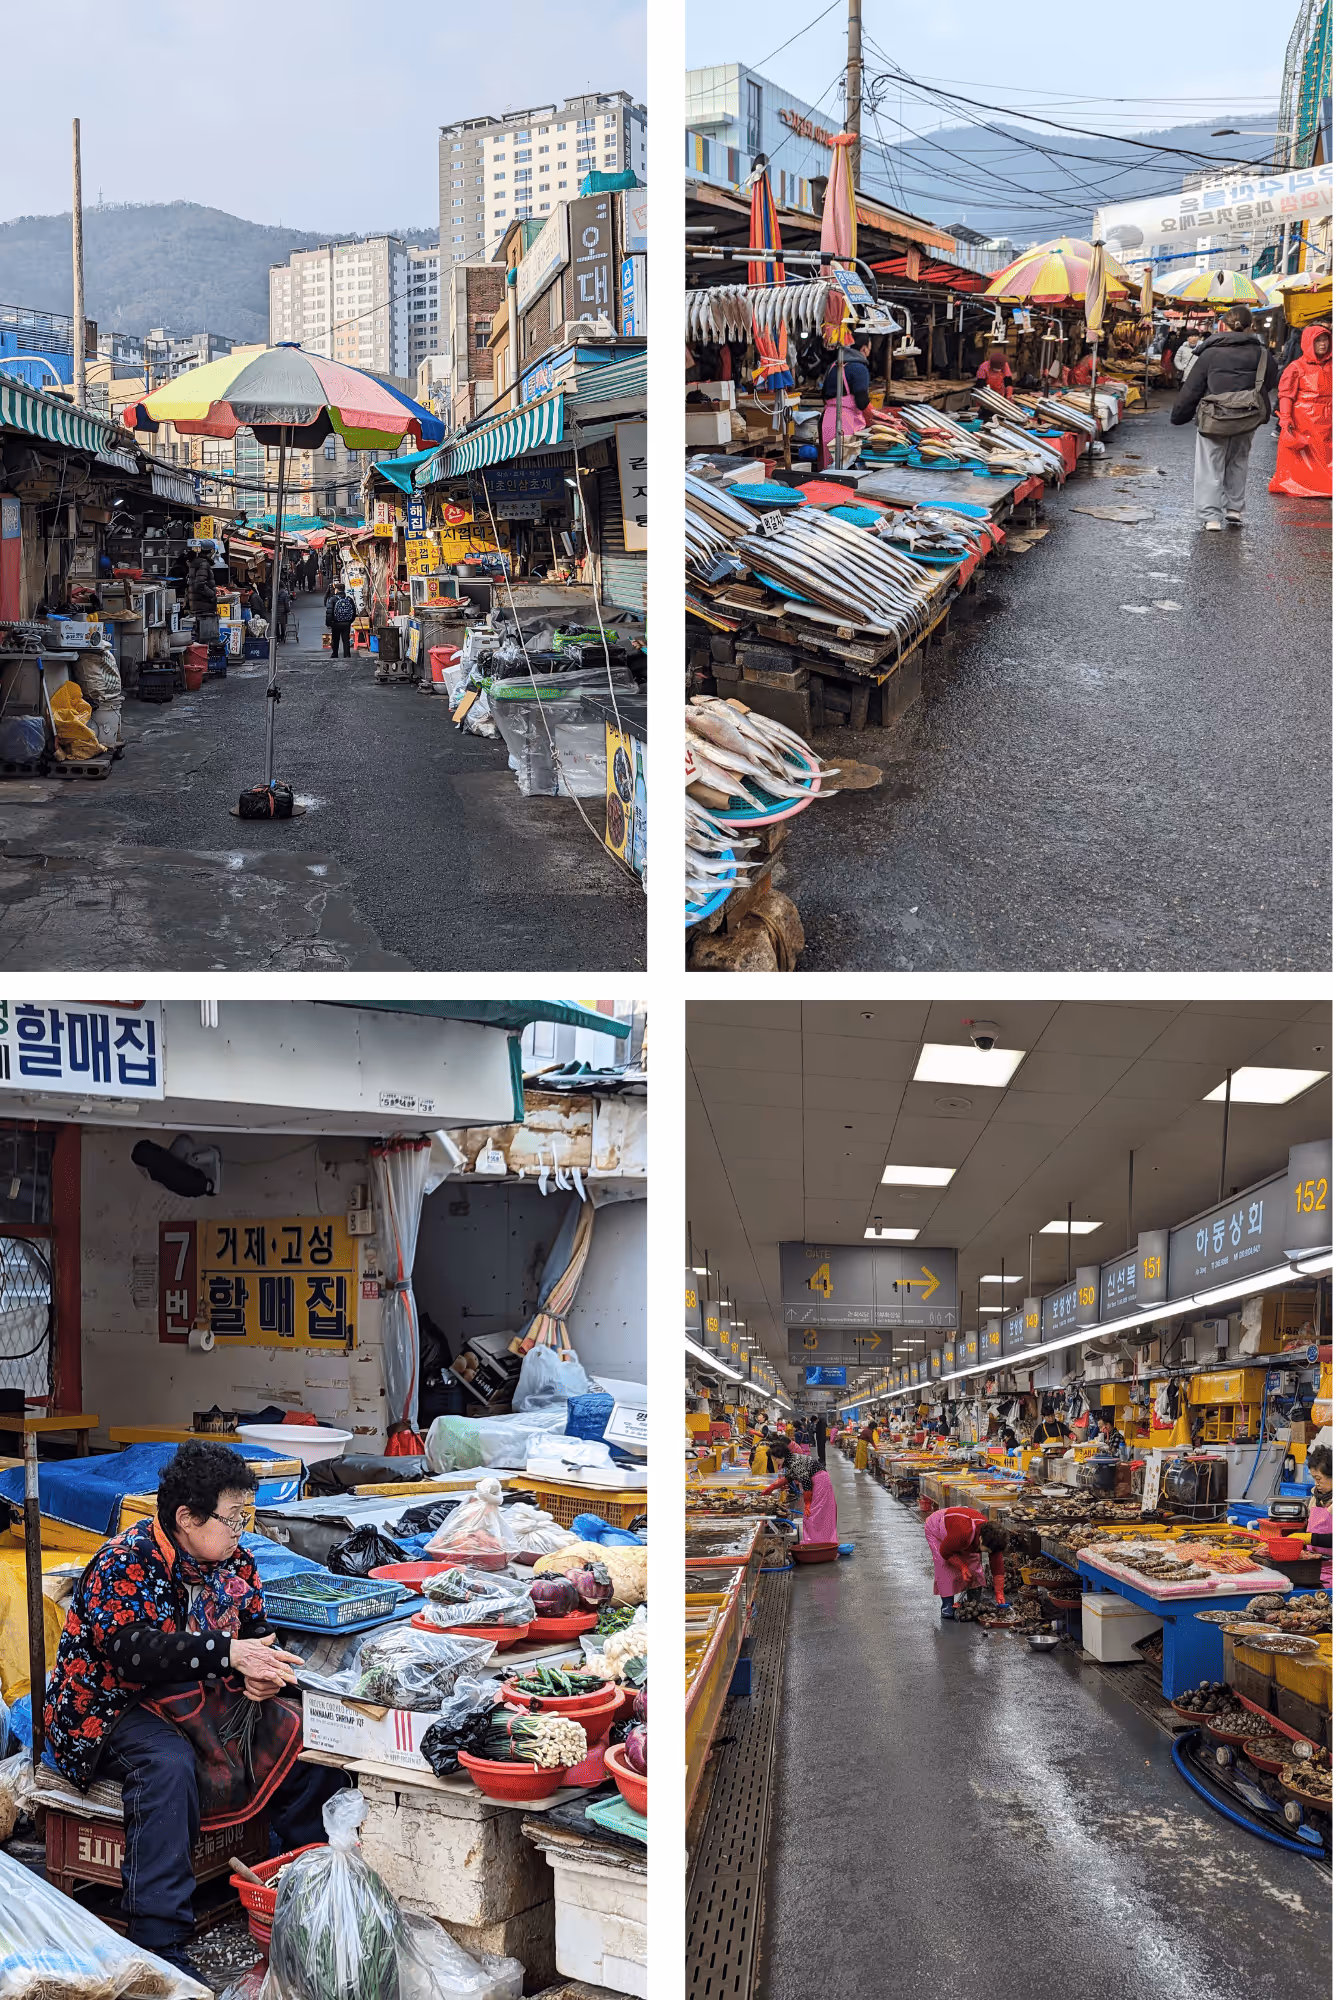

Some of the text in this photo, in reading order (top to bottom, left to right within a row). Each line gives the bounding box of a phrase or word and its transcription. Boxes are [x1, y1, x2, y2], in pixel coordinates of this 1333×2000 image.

[15, 1003, 156, 1087] 할매집
[1295, 1178, 1328, 1213] 152
[1196, 1200, 1263, 1257] 하동상회
[806, 1250, 831, 1258] GATE
[1143, 1256, 1161, 1279] 151
[806, 1263, 833, 1298] 4
[1079, 1286, 1095, 1306] 150
[209, 1276, 347, 1340] 할매집
[706, 1317, 718, 1331] 159
[1025, 1313, 1039, 1329] 149
[803, 1329, 818, 1349] 3
[966, 1342, 976, 1353] 147
[989, 1332, 1000, 1344] 148
[309, 1699, 325, 1710] FROZEN
[326, 1702, 345, 1713] COOKED
[309, 1707, 334, 1721] VANNAMEI
[335, 1711, 355, 1724] SHRIMP
[195, 1825, 244, 1859] 하이트맥주
